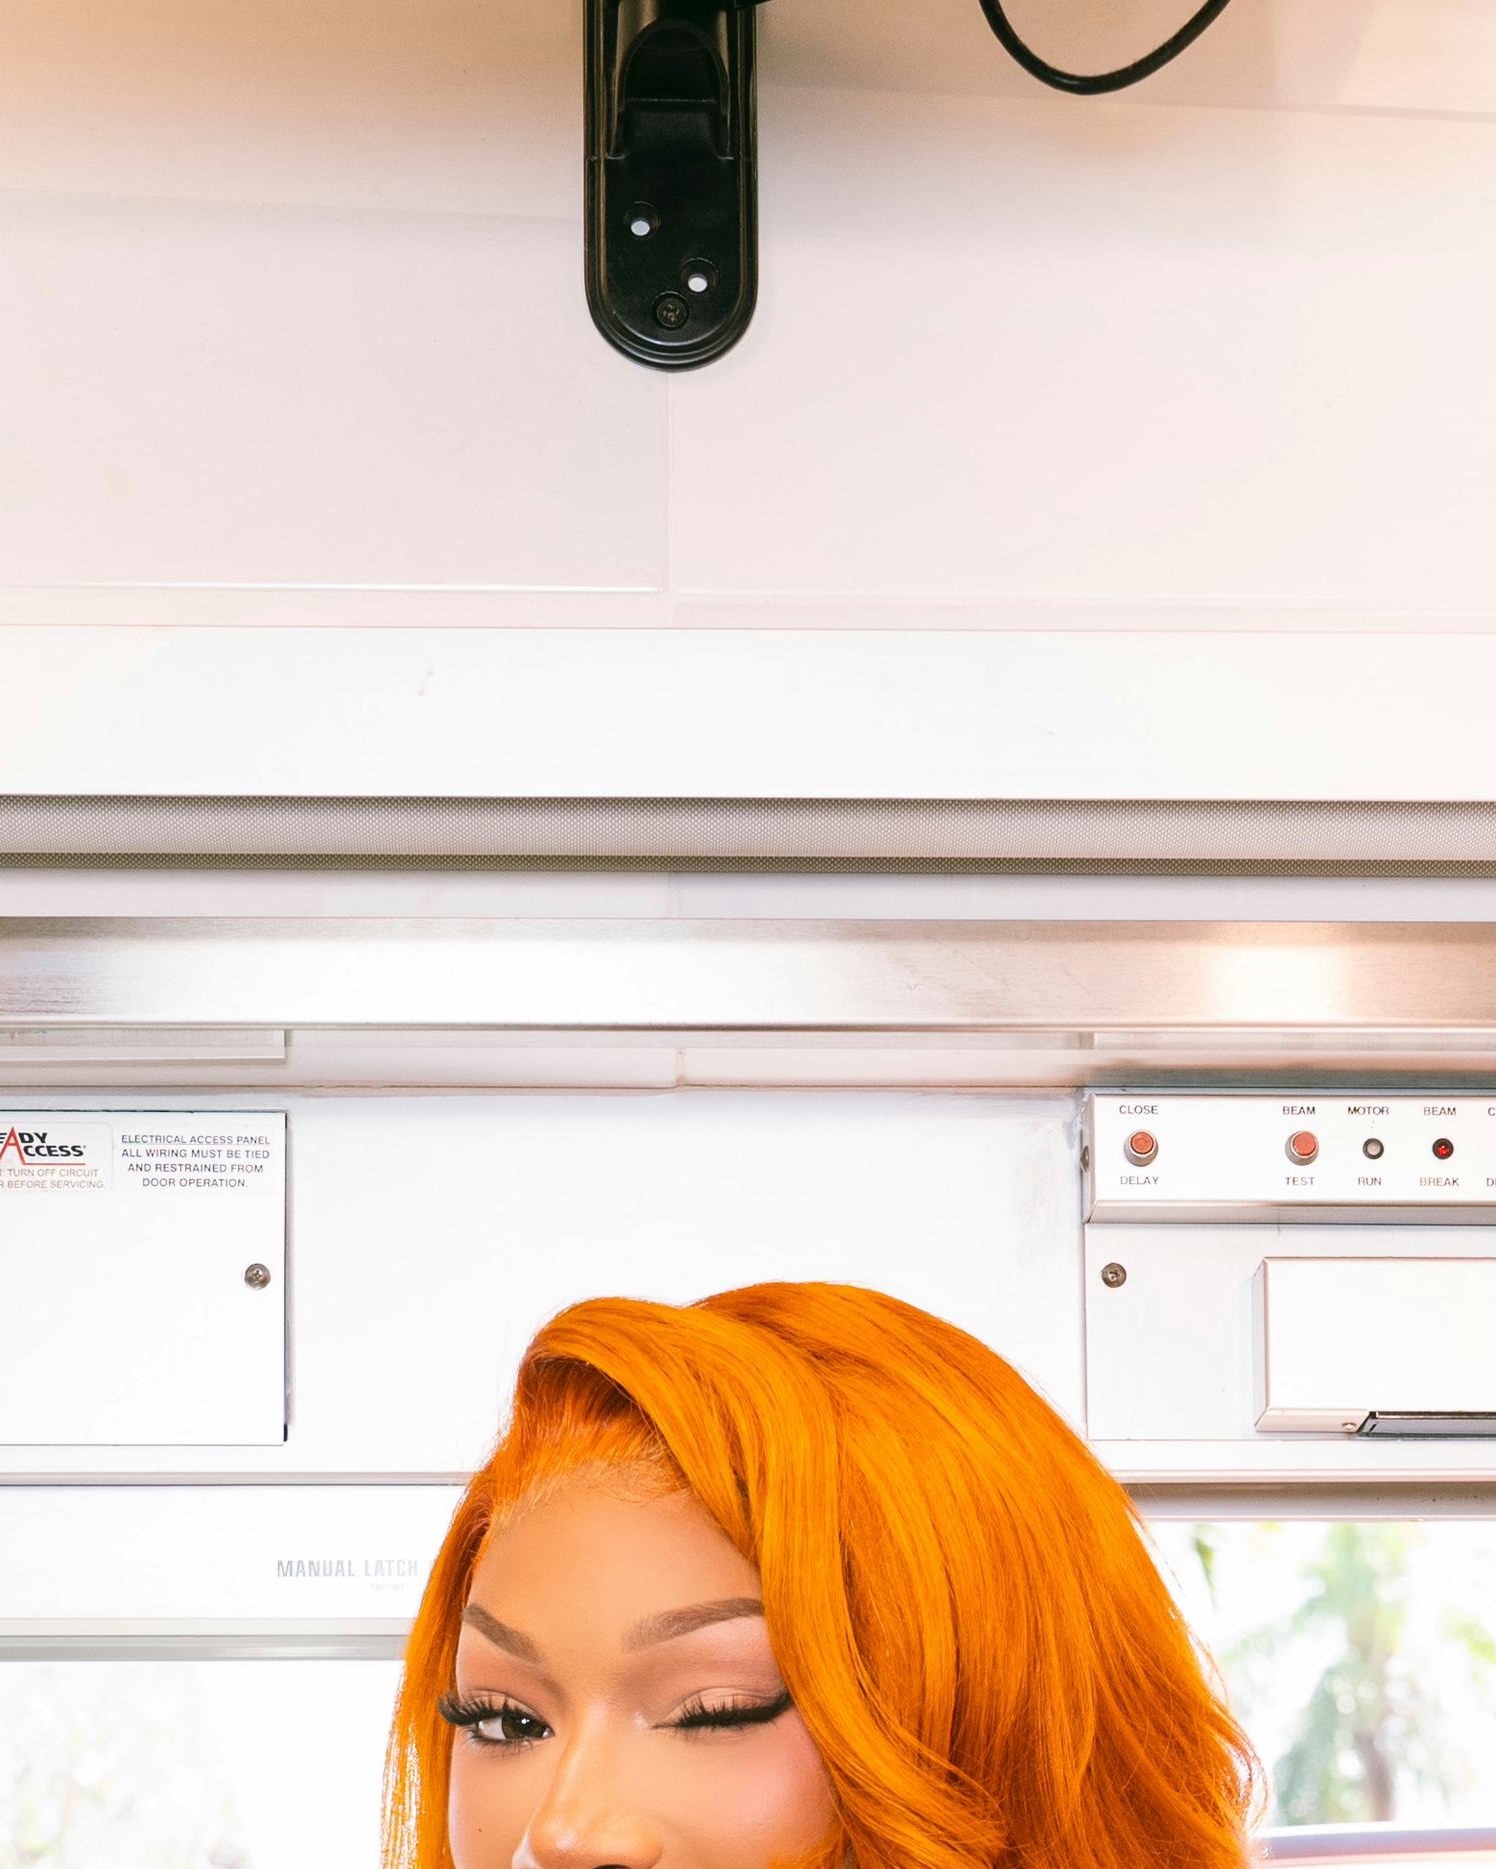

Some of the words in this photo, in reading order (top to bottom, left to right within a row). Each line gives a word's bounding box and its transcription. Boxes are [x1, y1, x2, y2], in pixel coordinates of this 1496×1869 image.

[1119, 1105, 1158, 1115] CLOSE
[1282, 1106, 1316, 1115] BEAM
[1347, 1106, 1390, 1115] MOTOR
[1423, 1106, 1457, 1116] BEAM
[121, 1134, 187, 1145] ELECTRICAL
[190, 1135, 234, 1145] ACCESS
[236, 1136, 271, 1146] PANEL
[121, 1149, 143, 1158] ALL
[146, 1149, 188, 1158] WIRING
[191, 1149, 222, 1159] MUST
[226, 1149, 242, 1159] BE
[245, 1149, 270, 1159] TIED
[7, 1168, 35, 1178] TURN
[37, 1168, 56, 1178] OFF
[59, 1168, 99, 1178] CIRCUIT
[127, 1163, 152, 1173] AND
[155, 1163, 227, 1174] RESTRAINED
[231, 1164, 264, 1174] FROM
[8, 1180, 48, 1189] BEFORE
[142, 1178, 176, 1188] DOOR
[179, 1178, 249, 1188] OPERATION.
[1120, 1175, 1159, 1185] DELAY
[1285, 1176, 1316, 1186] TEST
[1357, 1177, 1382, 1186] RUN
[1419, 1177, 1459, 1187] BREAK
[276, 1559, 357, 1578] MANUAL
[364, 1558, 418, 1577] LATCH
